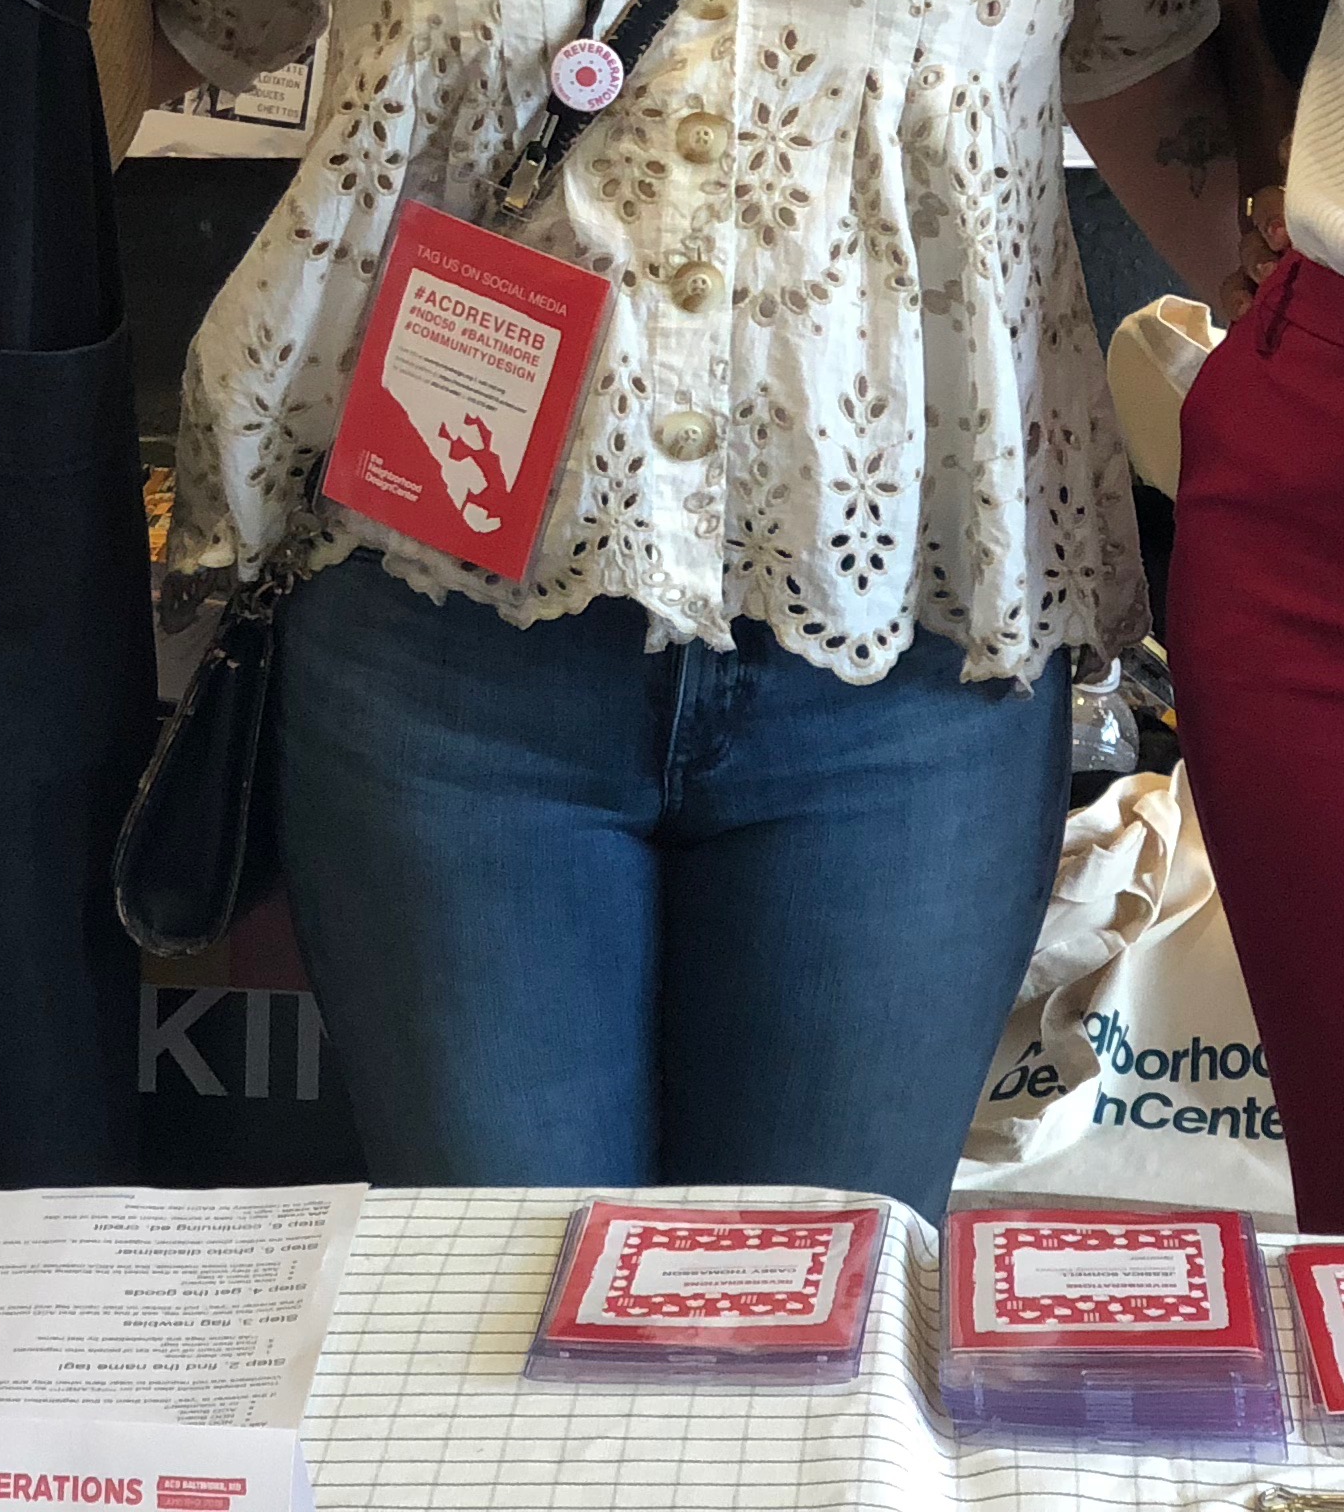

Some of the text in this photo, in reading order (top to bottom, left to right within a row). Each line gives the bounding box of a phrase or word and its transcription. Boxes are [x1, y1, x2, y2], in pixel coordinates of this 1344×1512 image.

[416, 244, 568, 317] TAG US ON SOCIAL MEDIA
[408, 305, 541, 368] #NDC50 #BALTIMORE
[413, 284, 547, 352] #ACDREVERB
[403, 320, 537, 384] #COMMUNITYDESIGN
